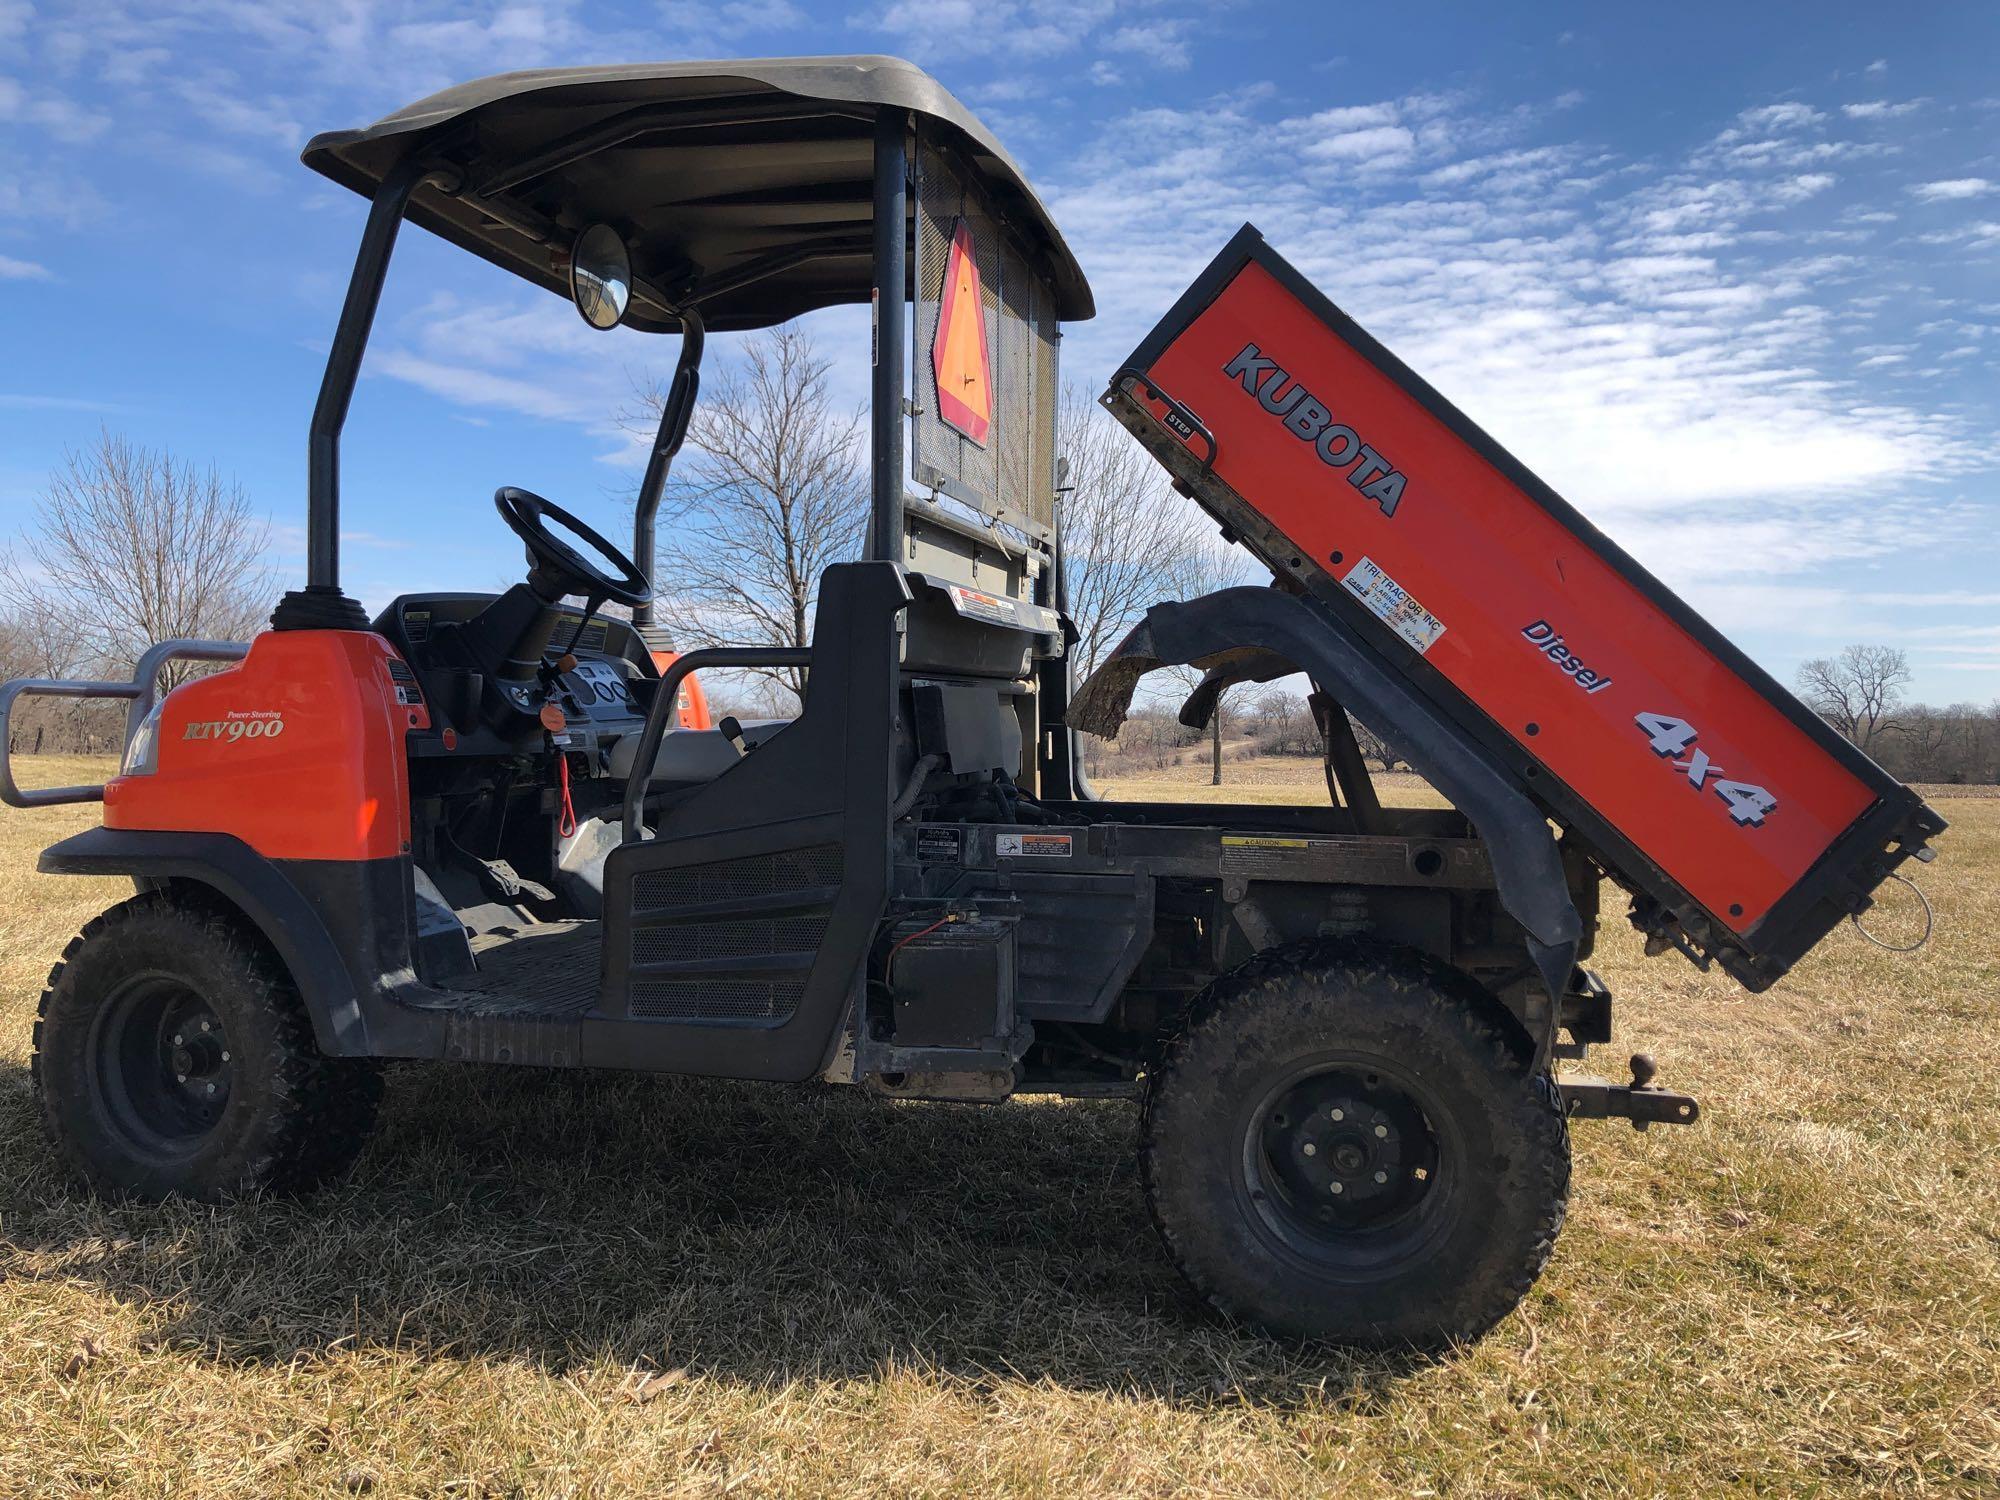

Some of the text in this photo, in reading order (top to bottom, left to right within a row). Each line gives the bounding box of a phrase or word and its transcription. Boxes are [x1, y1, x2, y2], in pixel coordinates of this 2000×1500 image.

[1169, 414, 1191, 434] STEP
[1223, 342, 1408, 518] KUBOTA
[1363, 561, 1423, 616] TRI-TRACTOR
[1422, 614, 1441, 631] INC
[1401, 609, 1418, 625] IOWA
[1521, 619, 1613, 694] Diesel
[227, 710, 281, 719] Power Steering
[182, 720, 284, 743] RTV900
[1250, 839, 1280, 847] CAUTION
